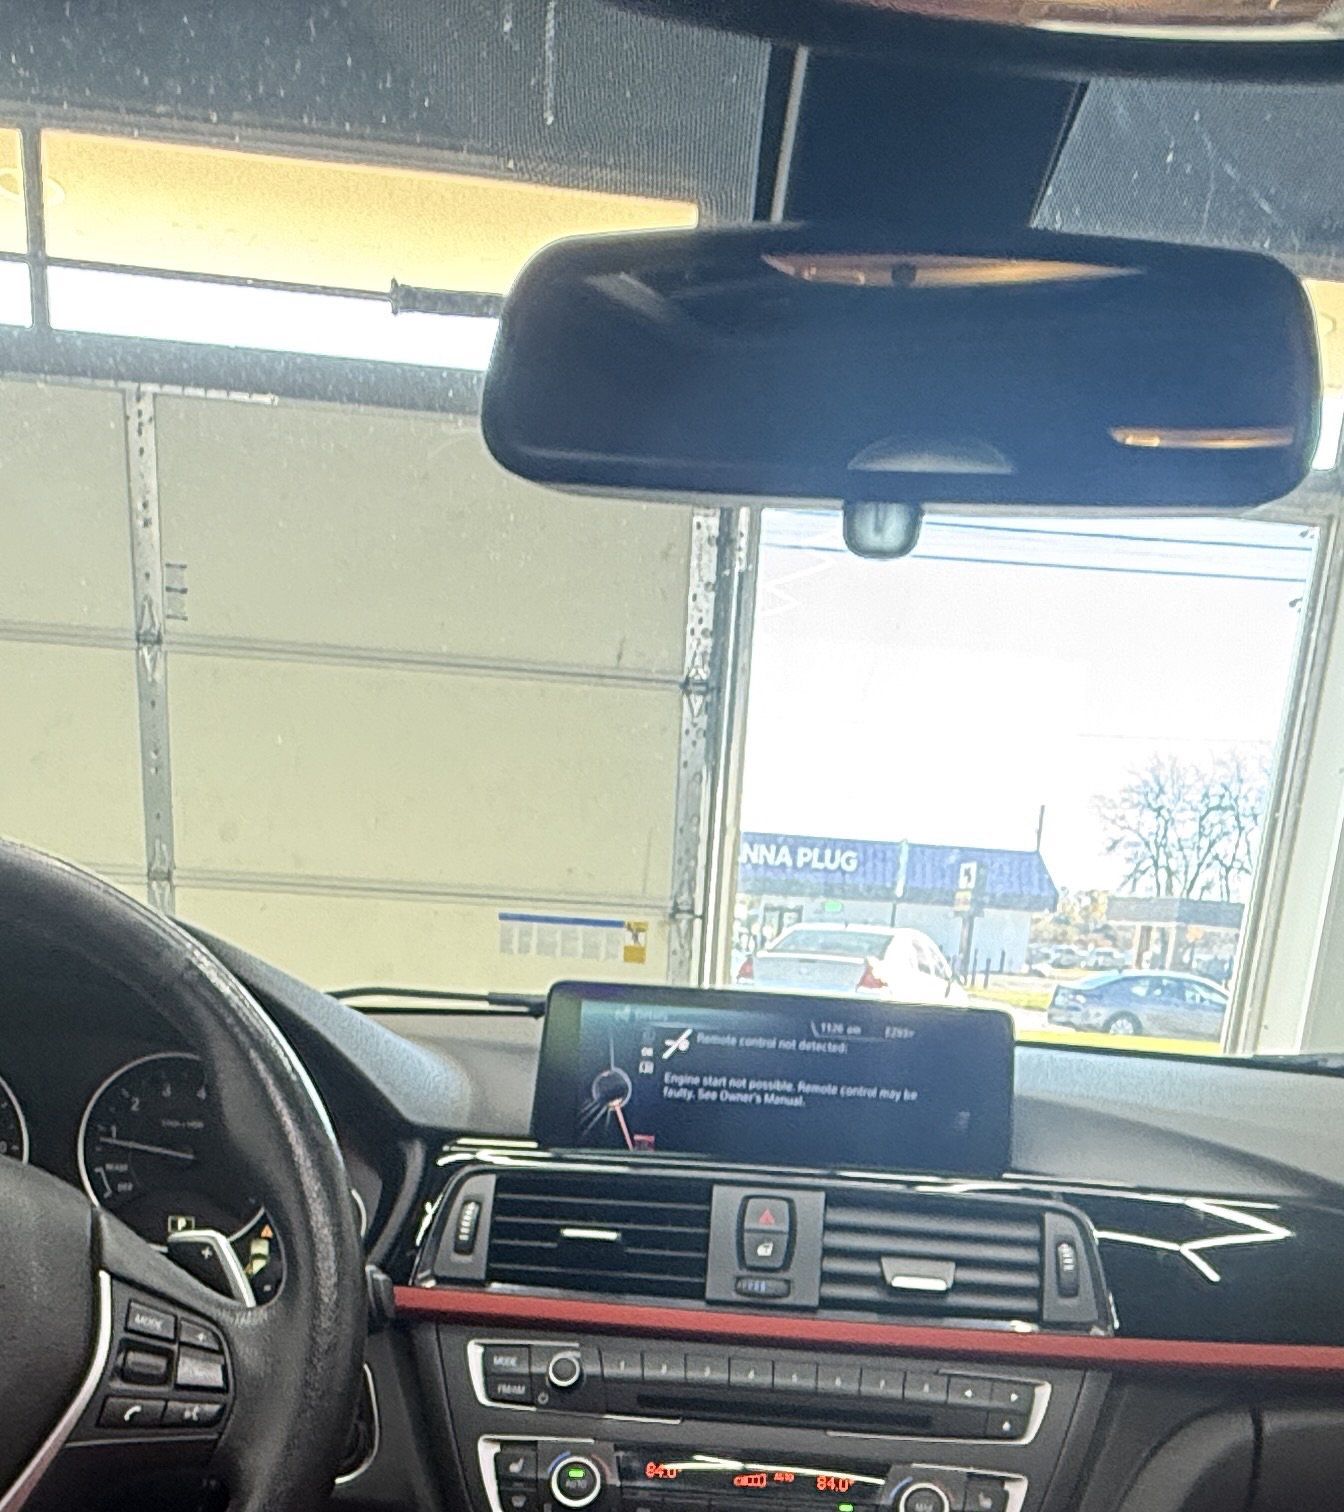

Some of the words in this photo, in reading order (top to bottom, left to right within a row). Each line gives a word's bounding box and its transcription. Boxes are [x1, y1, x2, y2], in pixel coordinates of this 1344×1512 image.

[739, 842, 793, 868] NNA
[797, 846, 859, 873] PLUG
[697, 1031, 737, 1047] Remote
[739, 1036, 777, 1049] control
[778, 1038, 797, 1050] not
[663, 1085, 696, 1101] faulty.
[698, 1087, 718, 1101] See
[719, 1089, 762, 1105] Owner's
[664, 1071, 700, 1087] Engine
[702, 1075, 727, 1087] start
[728, 1078, 747, 1089] not
[798, 1080, 838, 1095] Remote
[839, 1085, 878, 1098] control
[878, 1088, 902, 1103] may
[903, 1087, 918, 1101] be
[131, 1097, 141, 1112] 2
[135, 1313, 162, 1331] MODE
